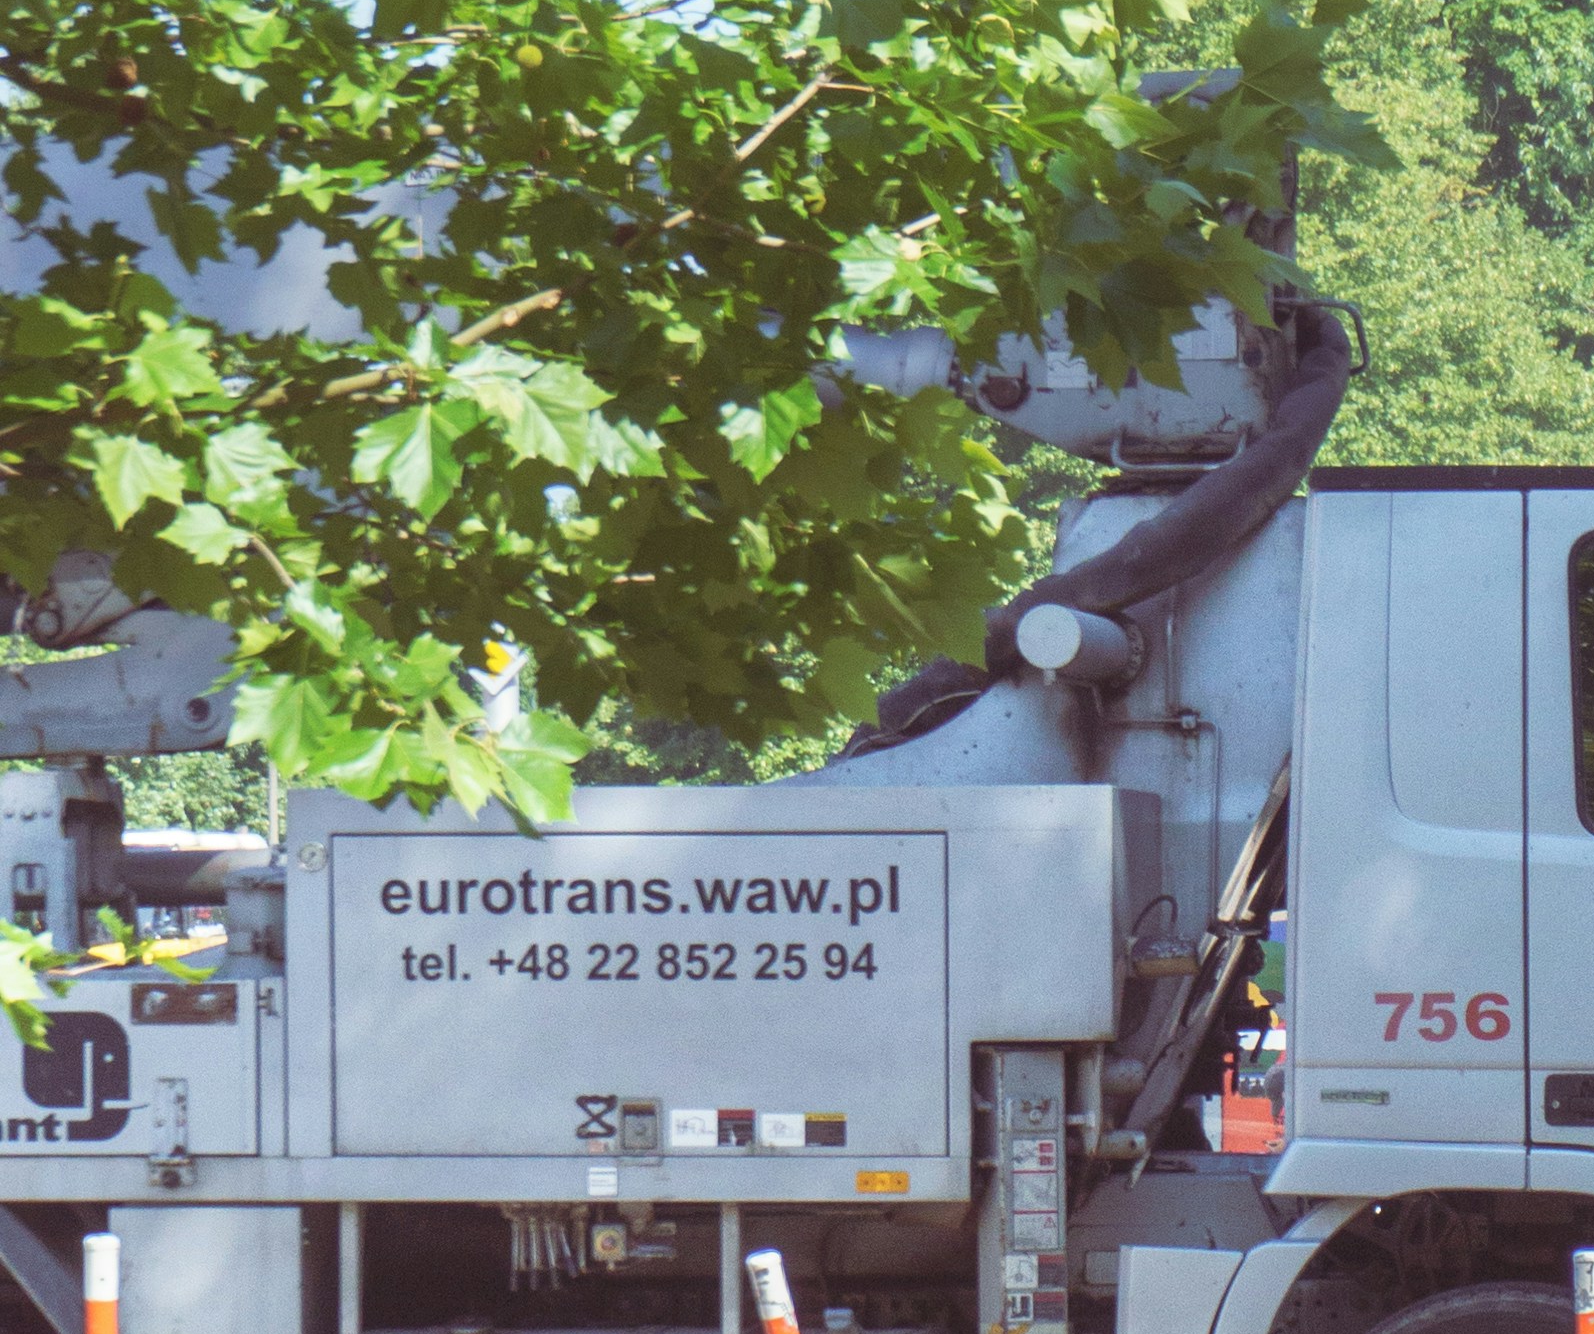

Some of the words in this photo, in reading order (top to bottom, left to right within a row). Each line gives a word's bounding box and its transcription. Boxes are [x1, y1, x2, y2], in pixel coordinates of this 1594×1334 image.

[380, 864, 899, 926] eurotrans.waw.pl
[402, 943, 472, 981] tel.
[489, 943, 570, 981] +48
[587, 943, 640, 981] 22
[657, 942, 737, 981] 852
[754, 942, 808, 981] 25
[823, 942, 879, 980] 94
[1374, 992, 1511, 1042] 756
